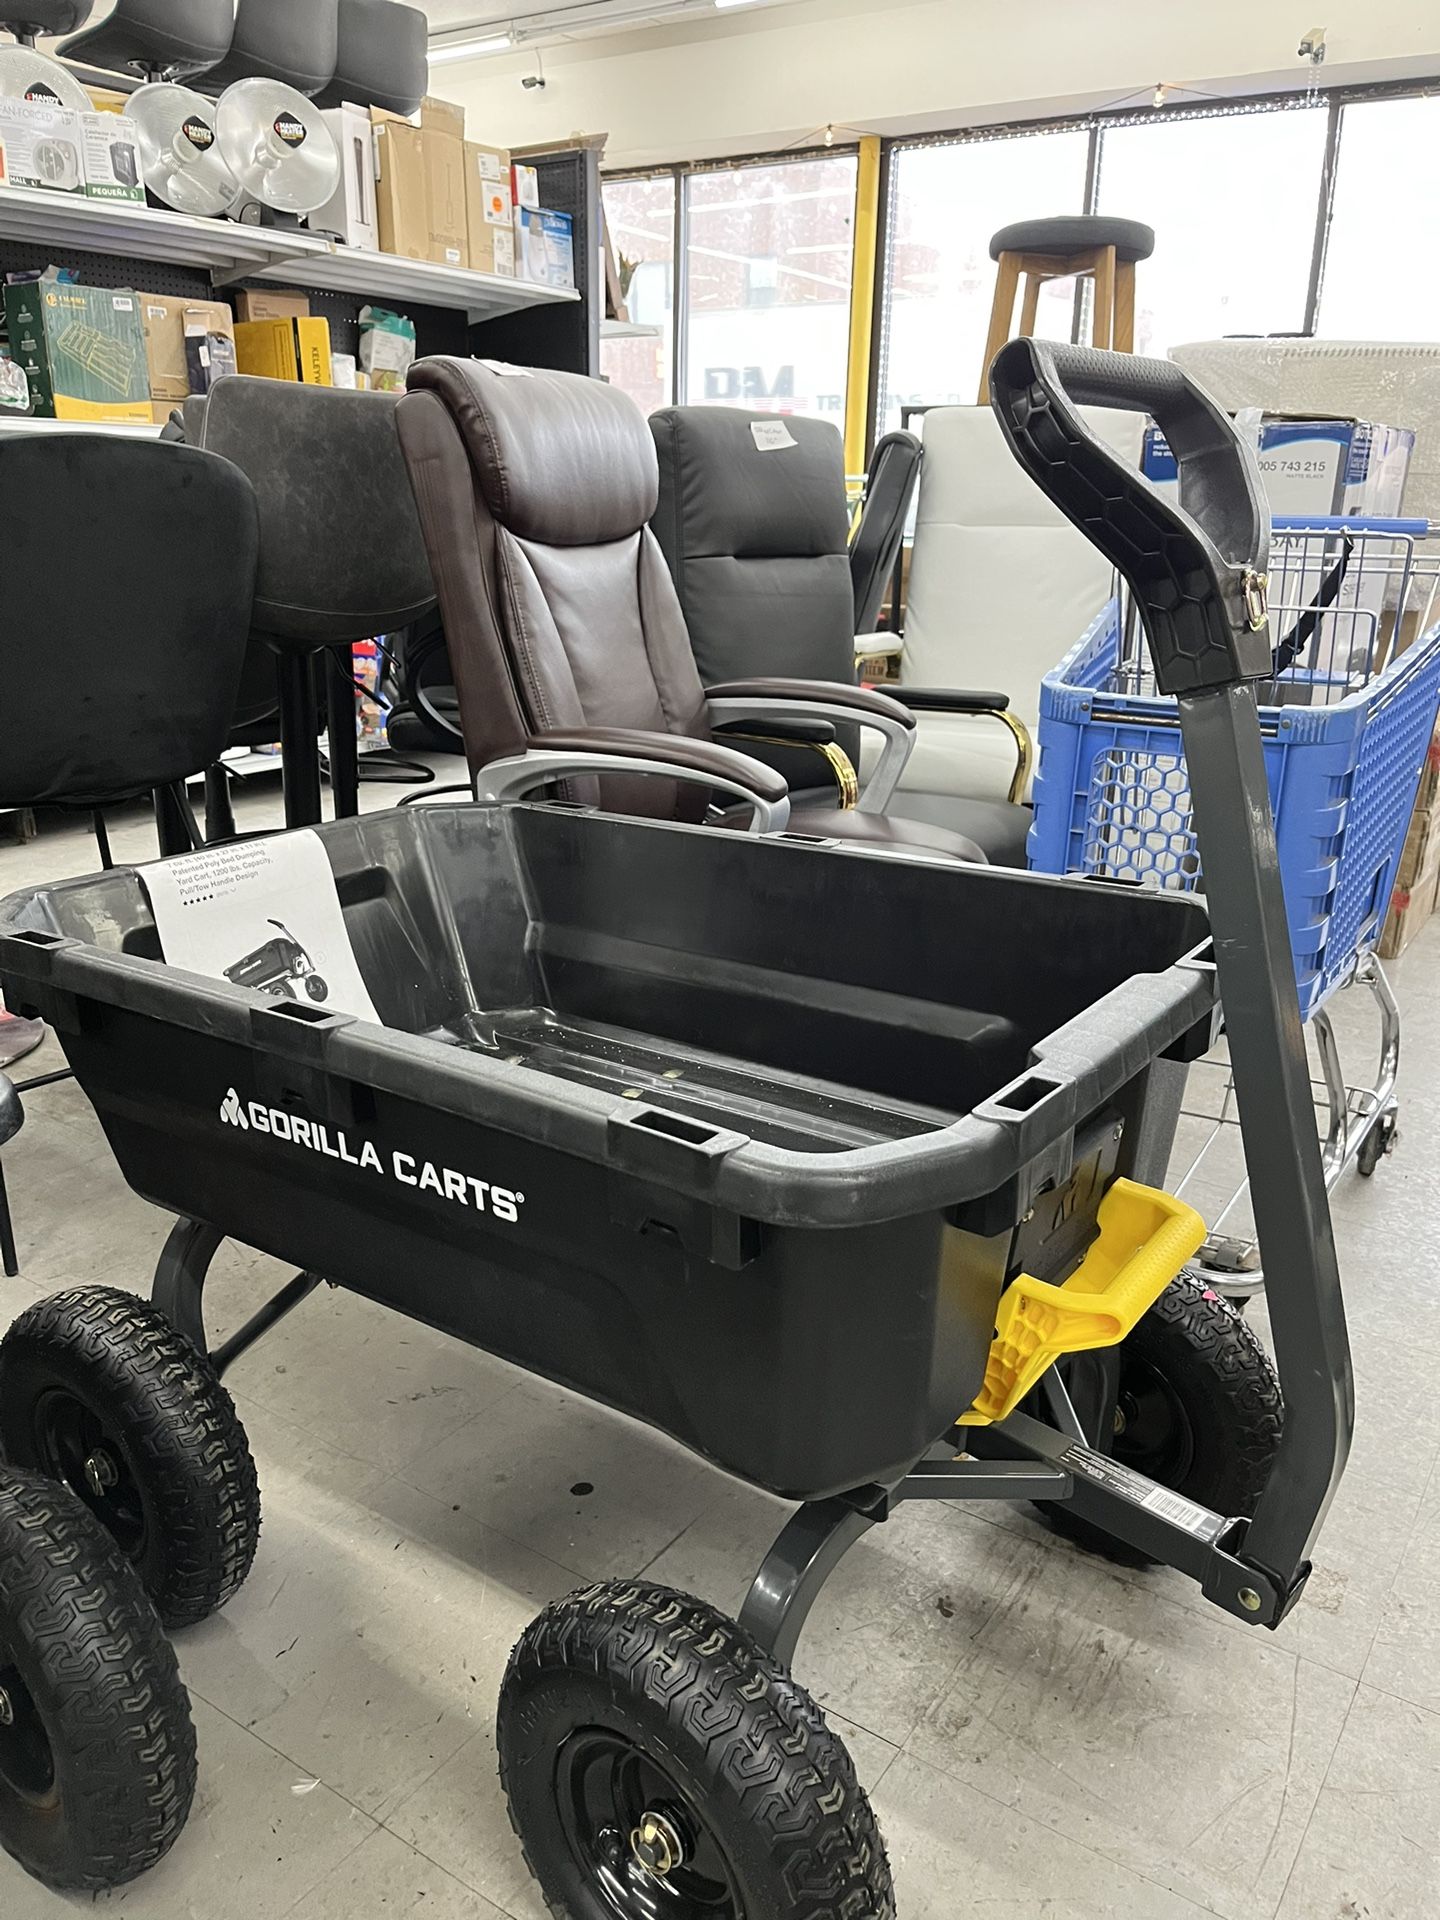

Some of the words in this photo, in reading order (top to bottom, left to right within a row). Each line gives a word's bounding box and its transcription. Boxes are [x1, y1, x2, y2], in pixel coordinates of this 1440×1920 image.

[92, 187, 128, 197] PEQUEÑA
[1281, 461, 1301, 472] 743
[1304, 461, 1326, 472] 215
[172, 862, 204, 876] Patented
[205, 858, 220, 869] Poly
[221, 855, 235, 864] Bed
[235, 849, 265, 861] Dumping
[176, 876, 194, 886] Yard
[213, 867, 229, 877] 1200
[179, 883, 210, 896] Pull/Tow
[210, 877, 234, 888] Handle
[235, 870, 259, 881] Design
[248, 1101, 384, 1174] GORILLA
